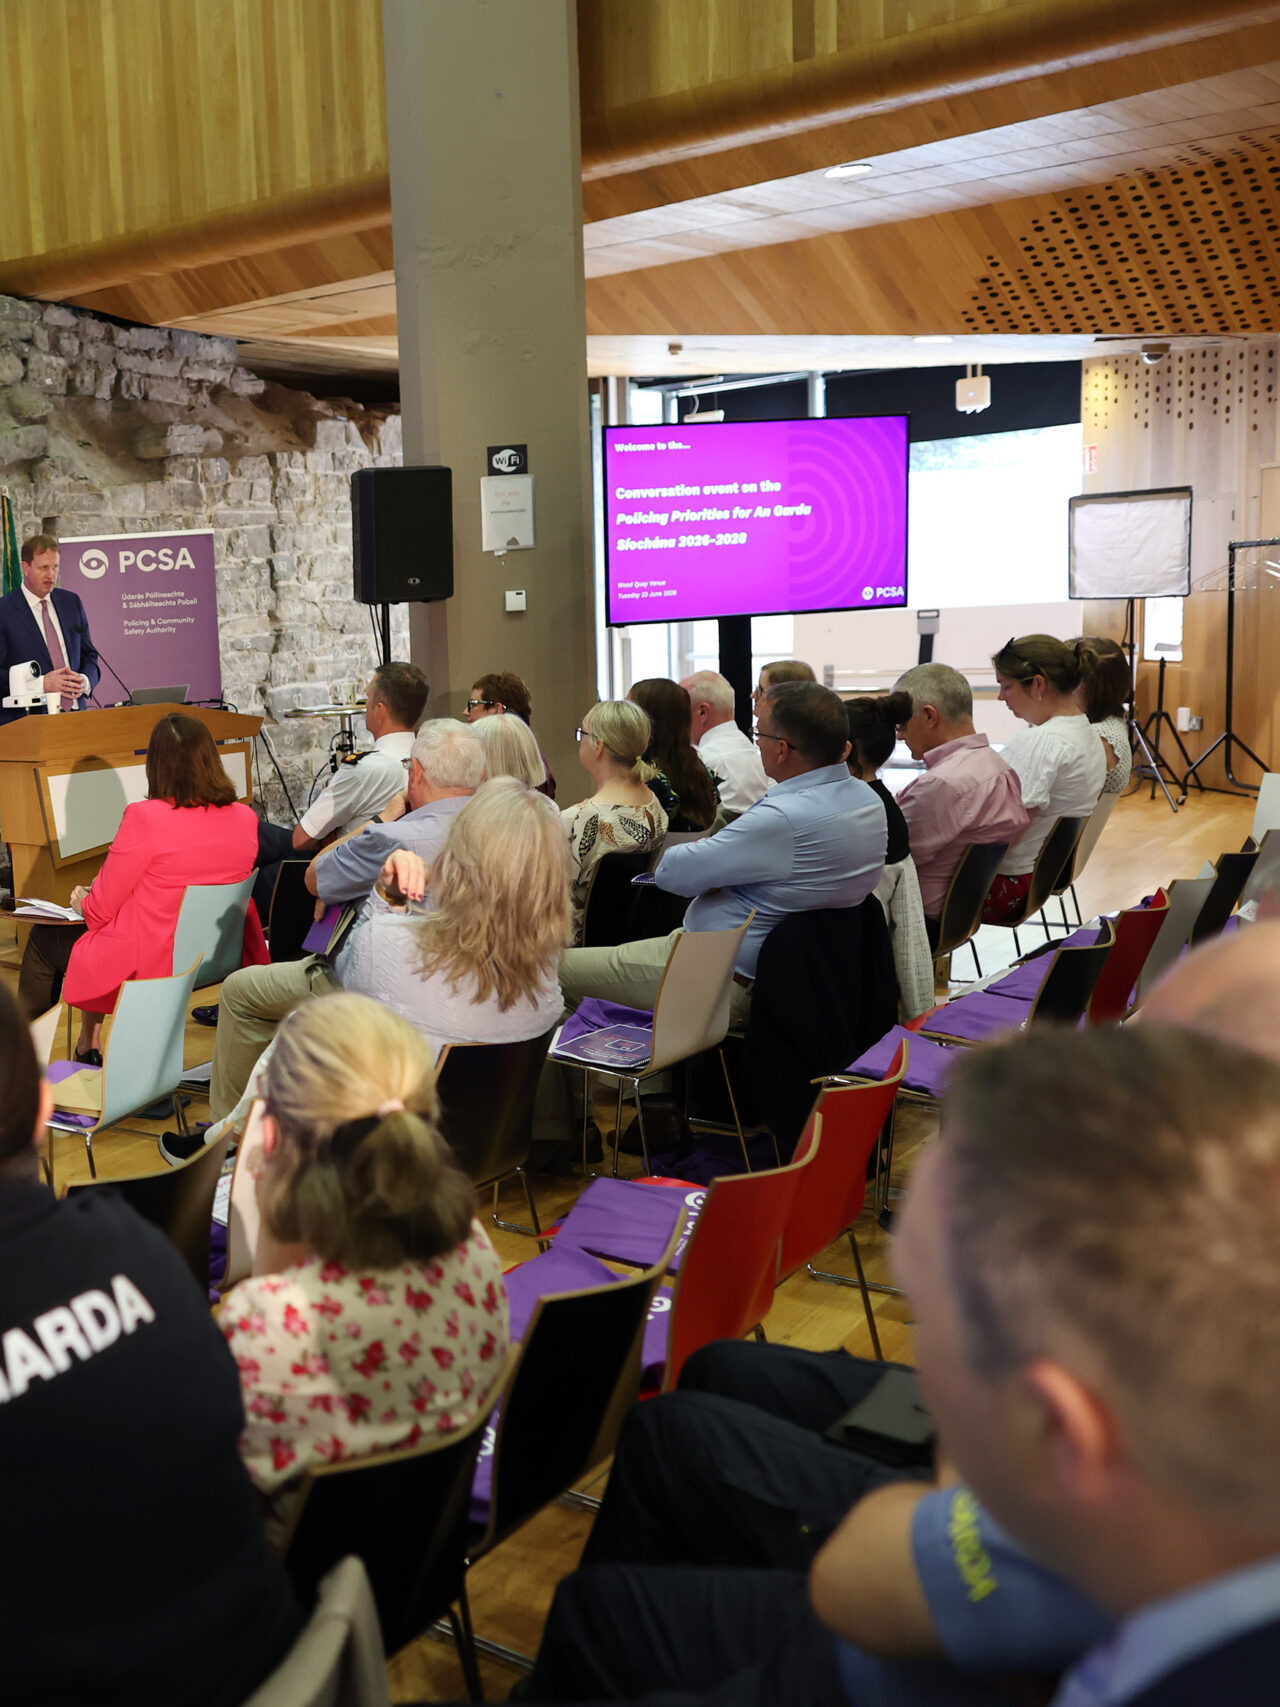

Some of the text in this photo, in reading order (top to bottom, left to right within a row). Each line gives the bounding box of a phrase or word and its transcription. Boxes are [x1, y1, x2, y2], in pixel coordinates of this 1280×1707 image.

[615, 442, 655, 452] Welcome
[657, 442, 666, 451] to
[616, 480, 781, 500] Conversation event on the
[616, 503, 812, 526] Policing Priorities for An Garda
[678, 532, 747, 548] 2026-2028
[118, 547, 196, 574] PCSA
[876, 586, 905, 599] PCSA
[177, 598, 198, 606] Pobail
[123, 619, 149, 627] Policing
[157, 616, 195, 625] Community
[124, 626, 176, 636] Safety Authority
